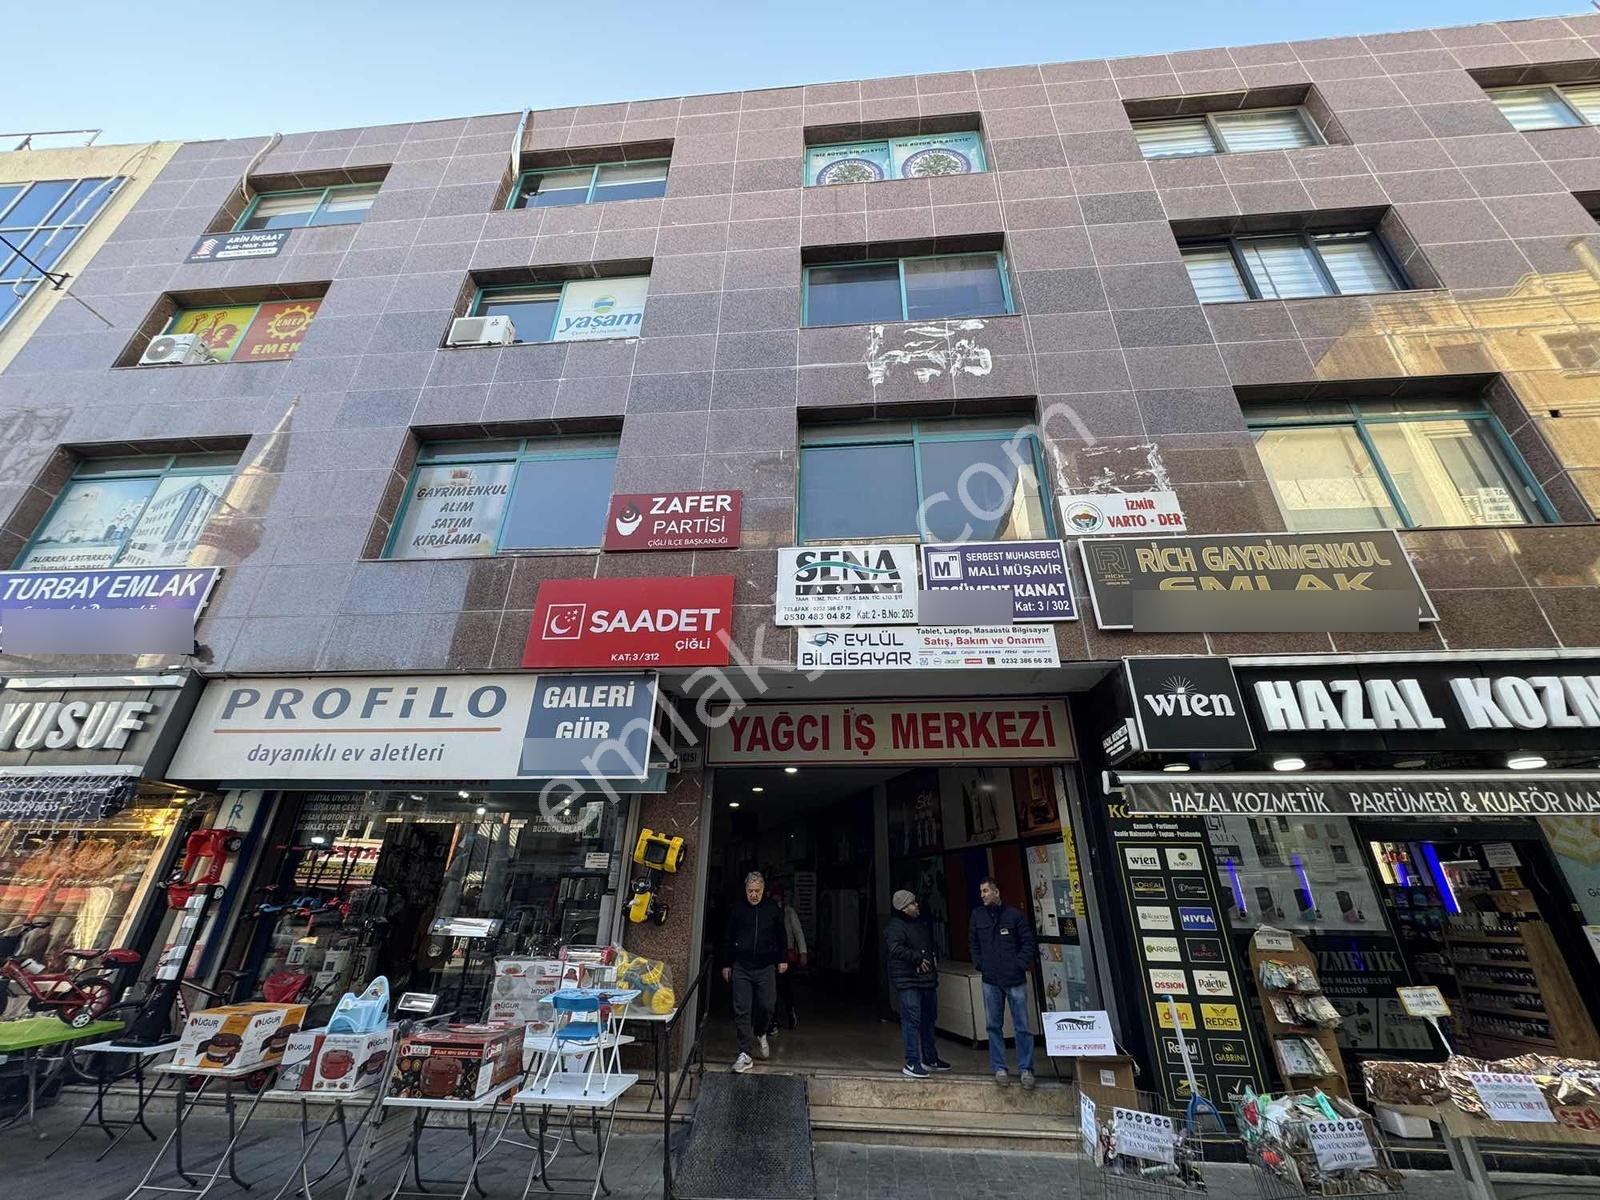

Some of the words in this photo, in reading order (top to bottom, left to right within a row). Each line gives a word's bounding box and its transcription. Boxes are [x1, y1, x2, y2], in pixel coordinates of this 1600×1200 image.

[559, 312, 643, 333] yaşam
[440, 501, 475, 513] ALIM
[649, 494, 733, 515] ZAFER
[1124, 497, 1156, 511] İZMİR
[431, 517, 473, 529] SATIM
[653, 516, 726, 535] PARTİSİ
[1107, 514, 1147, 528] VARTO
[1157, 513, 1183, 526] DER
[412, 532, 482, 547] KİRALAMA
[965, 551, 1004, 562] SERBEST
[1005, 548, 1061, 560] MUHASEBECİ
[1135, 542, 1198, 573] RİCH
[1202, 539, 1392, 573] GAYRİMENKUL
[795, 549, 901, 583] SENA
[968, 564, 1000, 577] MALİ
[1003, 562, 1063, 578] MÜŞAVİR
[3, 575, 110, 601] TURBAY
[106, 573, 203, 599] EMLAK
[800, 583, 897, 594] İNŞAAT
[1014, 582, 1066, 598] KANAT
[1015, 601, 1036, 612] Kat:
[1038, 601, 1044, 612] 3
[1052, 600, 1070, 611] 302
[589, 608, 720, 633] SAADET
[856, 610, 871, 620] Kat:
[871, 609, 876, 619] 2
[901, 608, 914, 619] 205
[916, 627, 942, 635] Tablet,
[943, 627, 972, 635] Laptop,
[973, 626, 1011, 634] Masaüstü
[1011, 626, 1050, 635] Bilgisayar
[675, 637, 710, 652] ÇİĞLİ
[844, 630, 904, 647] EYLÜL
[924, 637, 953, 647] Satış,
[956, 636, 989, 646] Bakım
[991, 637, 1004, 645] ve
[1006, 636, 1045, 645] Onarım
[802, 649, 912, 666] BİLGİSAYAR
[542, 680, 636, 709] GALERİ
[1143, 686, 1237, 718] wien
[1253, 678, 1448, 732] HAZAL
[0, 700, 154, 751] YUSUF
[728, 711, 830, 752] YAĞCI
[843, 708, 876, 756] İŞ
[891, 705, 1057, 750] MERKEZİ
[247, 743, 335, 764] dayanıklı
[341, 748, 365, 762] ev
[369, 742, 445, 762] aletleri
[1170, 791, 1231, 813] HAZAL
[1233, 787, 1331, 813] KOZMETİK
[1350, 786, 1459, 813] PARFÜMERİ
[1461, 792, 1478, 813] &
[1478, 784, 1560, 812] KUAFÖR
[1129, 855, 1157, 865] wien
[1182, 914, 1214, 923] NIVEA
[1145, 944, 1178, 953] GARNIER
[1154, 981, 1185, 990] OSSION
[1198, 978, 1228, 989] Palette
[1205, 1017, 1239, 1027] REDIST
[1167, 1041, 1198, 1055] Reul
